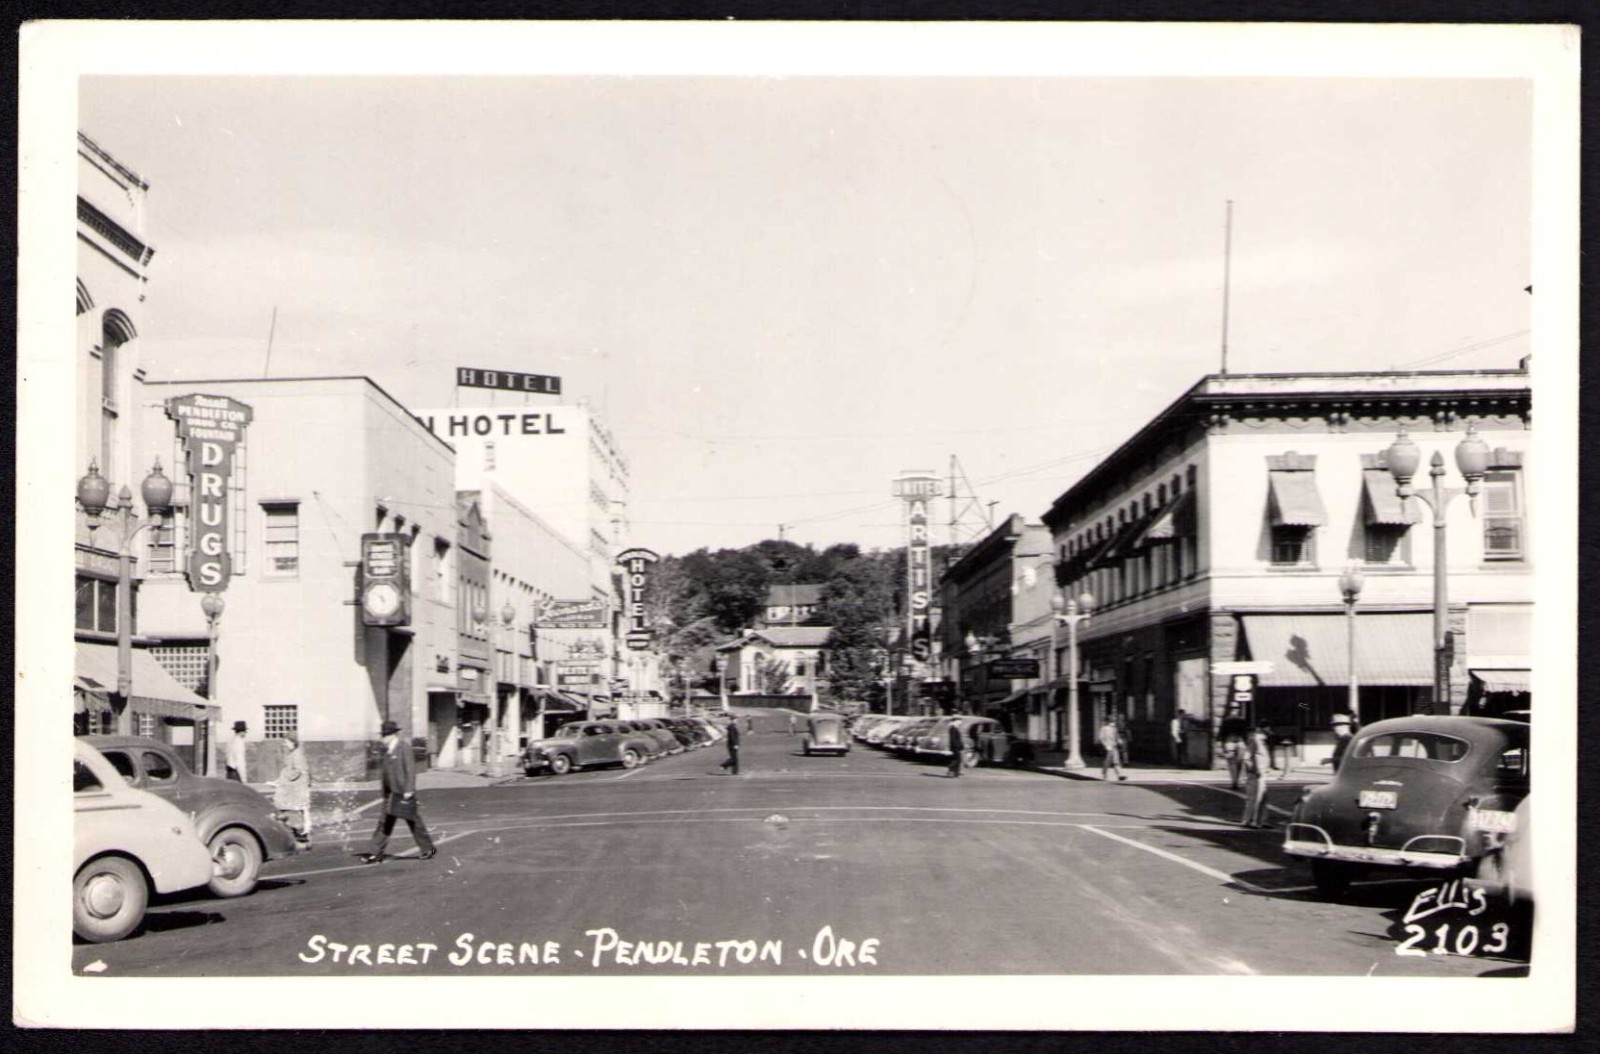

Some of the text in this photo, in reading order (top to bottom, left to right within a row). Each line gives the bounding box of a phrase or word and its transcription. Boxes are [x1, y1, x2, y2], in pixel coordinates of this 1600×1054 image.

[460, 369, 559, 393] HOTEL
[178, 404, 245, 422] PENDLETON
[449, 413, 565, 437] HOTEL
[189, 427, 236, 441] FOUNTAIN
[200, 441, 223, 586] DRUGS
[910, 500, 930, 659] ARTISTS
[630, 558, 647, 631] HOTEL
